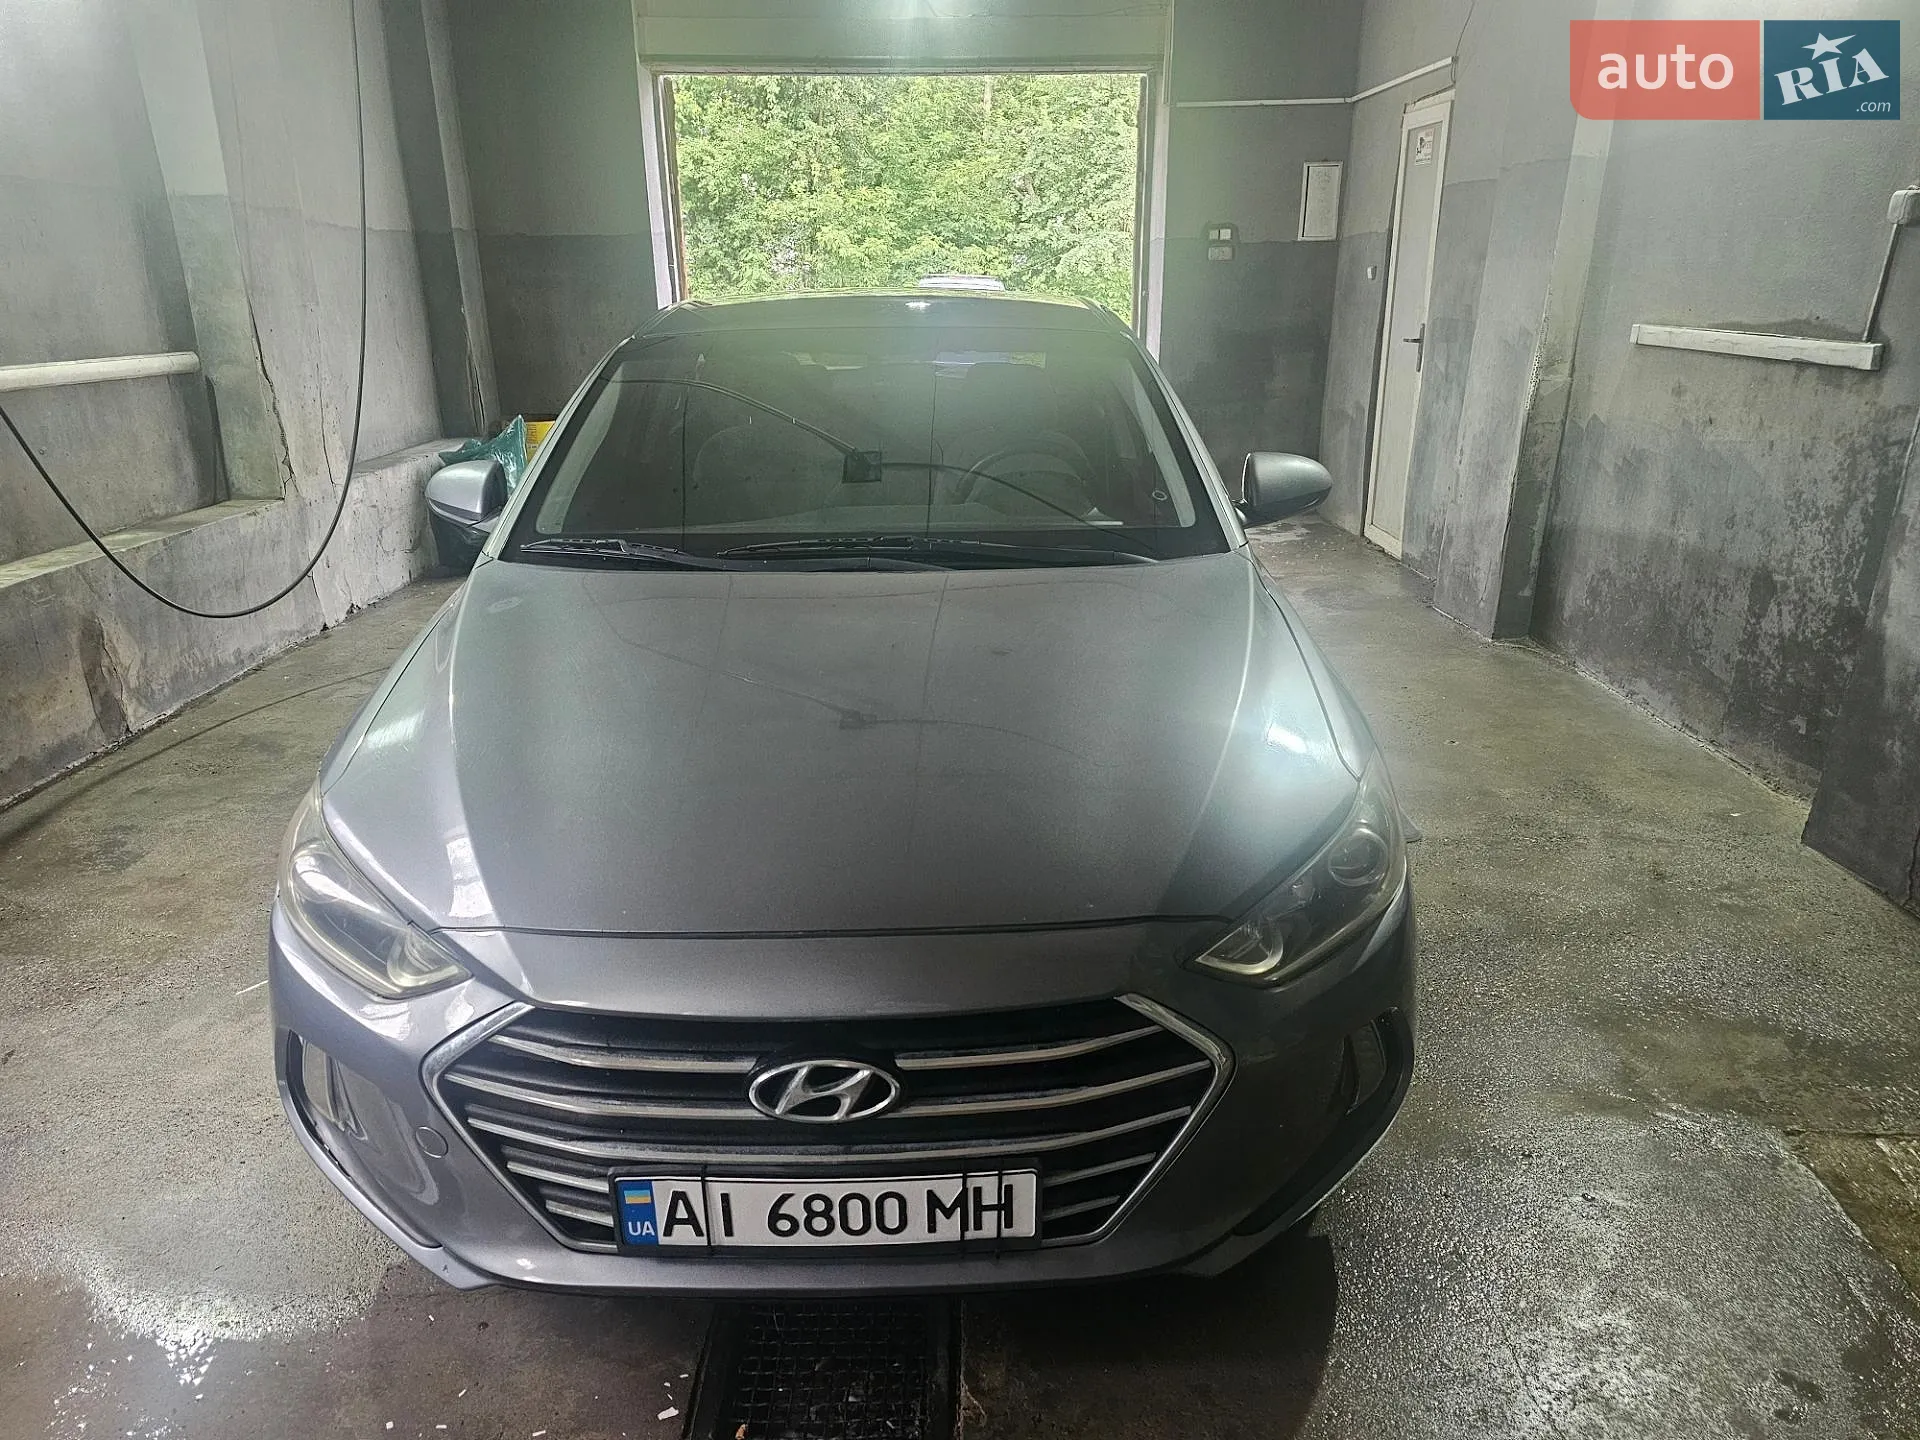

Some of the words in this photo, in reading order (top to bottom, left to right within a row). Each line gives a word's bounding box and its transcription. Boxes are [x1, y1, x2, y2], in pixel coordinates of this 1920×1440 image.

[628, 1220, 656, 1237] UA
[662, 1190, 735, 1238] AI
[767, 1190, 907, 1238] 6800
[926, 1183, 1015, 1234] MH
